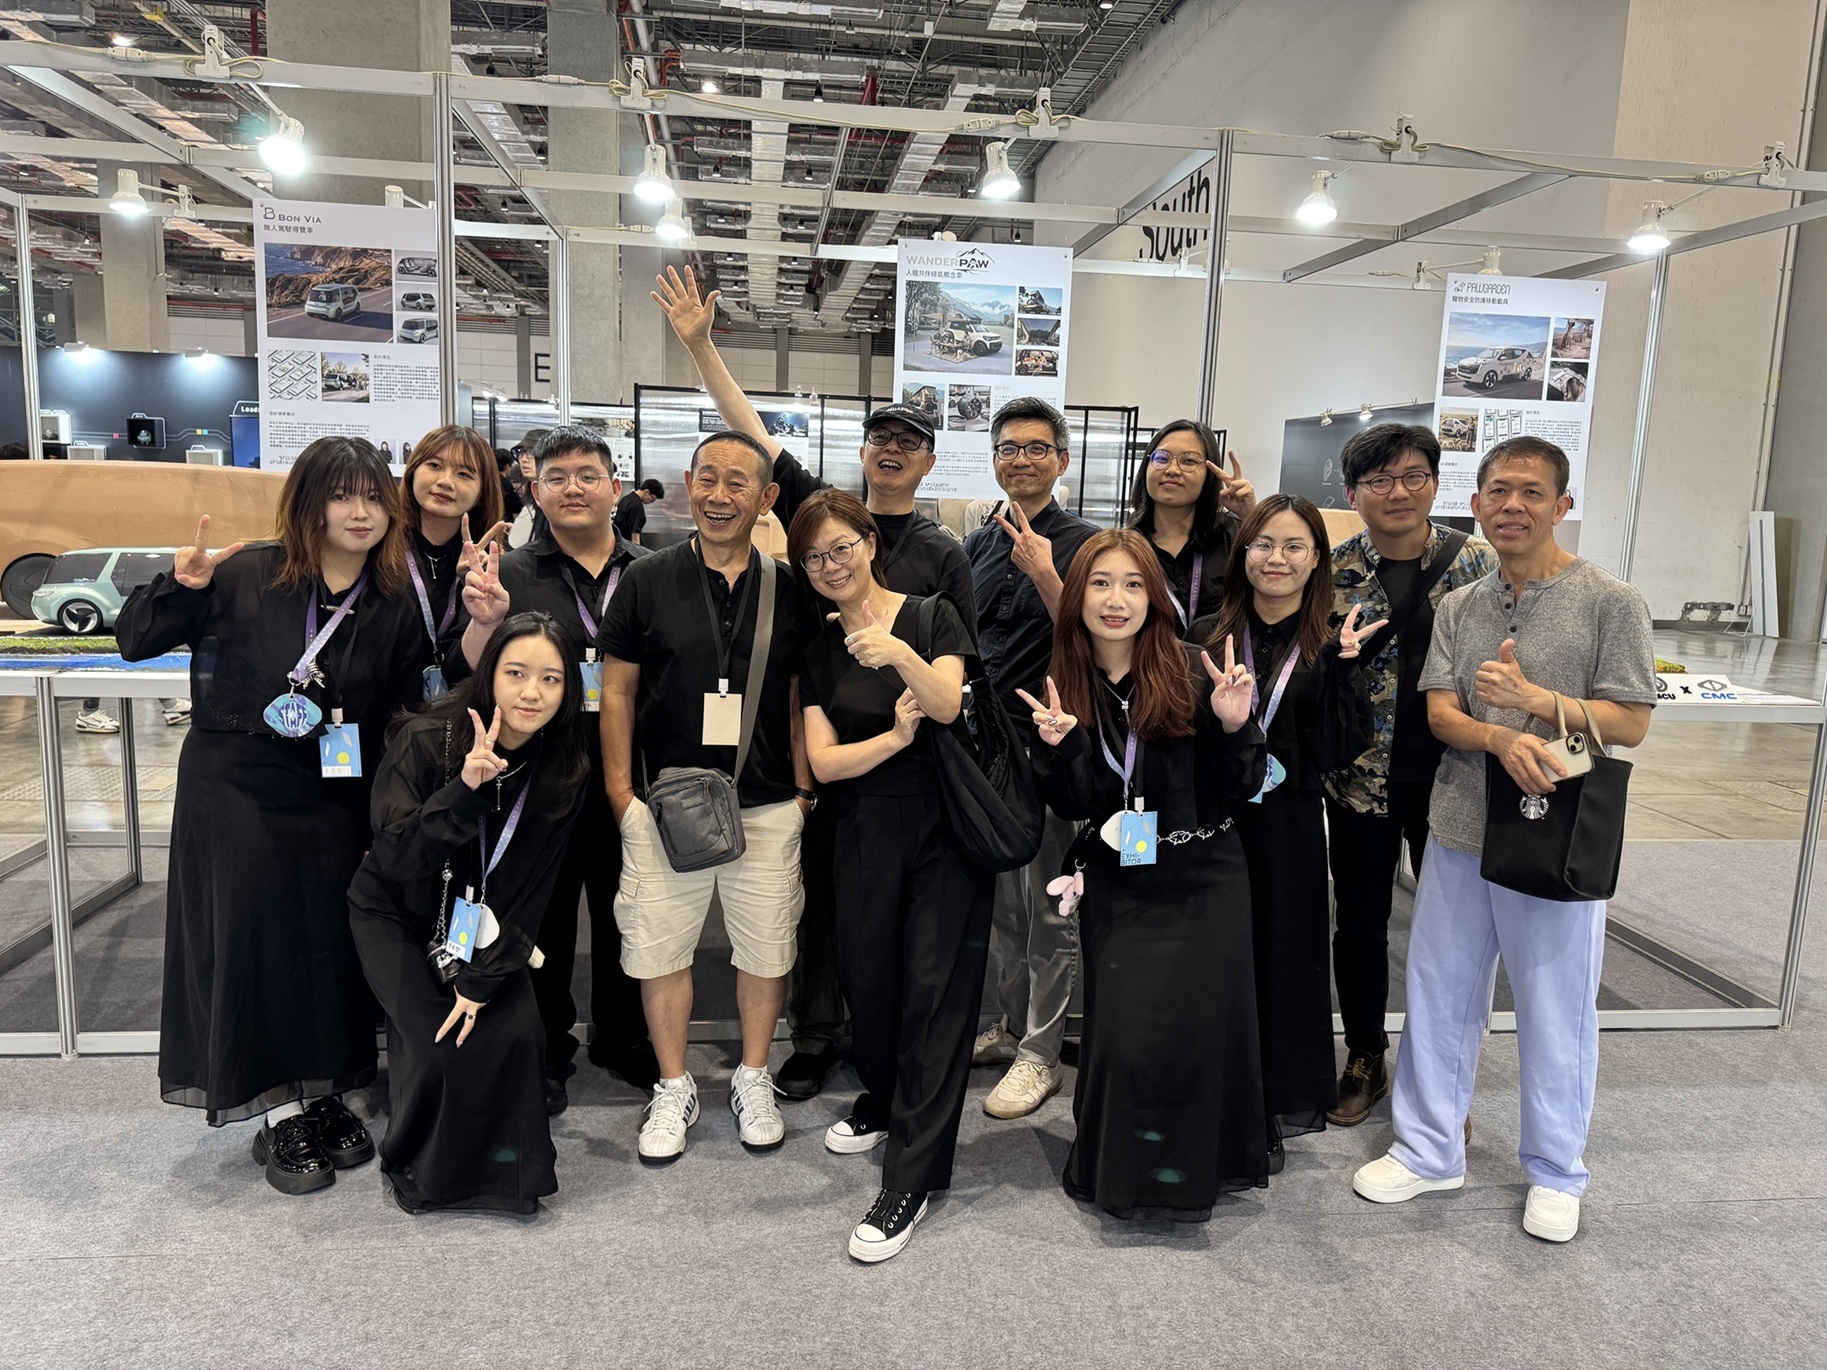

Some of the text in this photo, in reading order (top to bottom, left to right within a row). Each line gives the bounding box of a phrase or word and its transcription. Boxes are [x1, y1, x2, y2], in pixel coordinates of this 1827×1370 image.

[278, 214, 301, 222] BON
[304, 215, 322, 224] VIA
[534, 352, 551, 383] E
[1700, 692, 1738, 700] CMC
